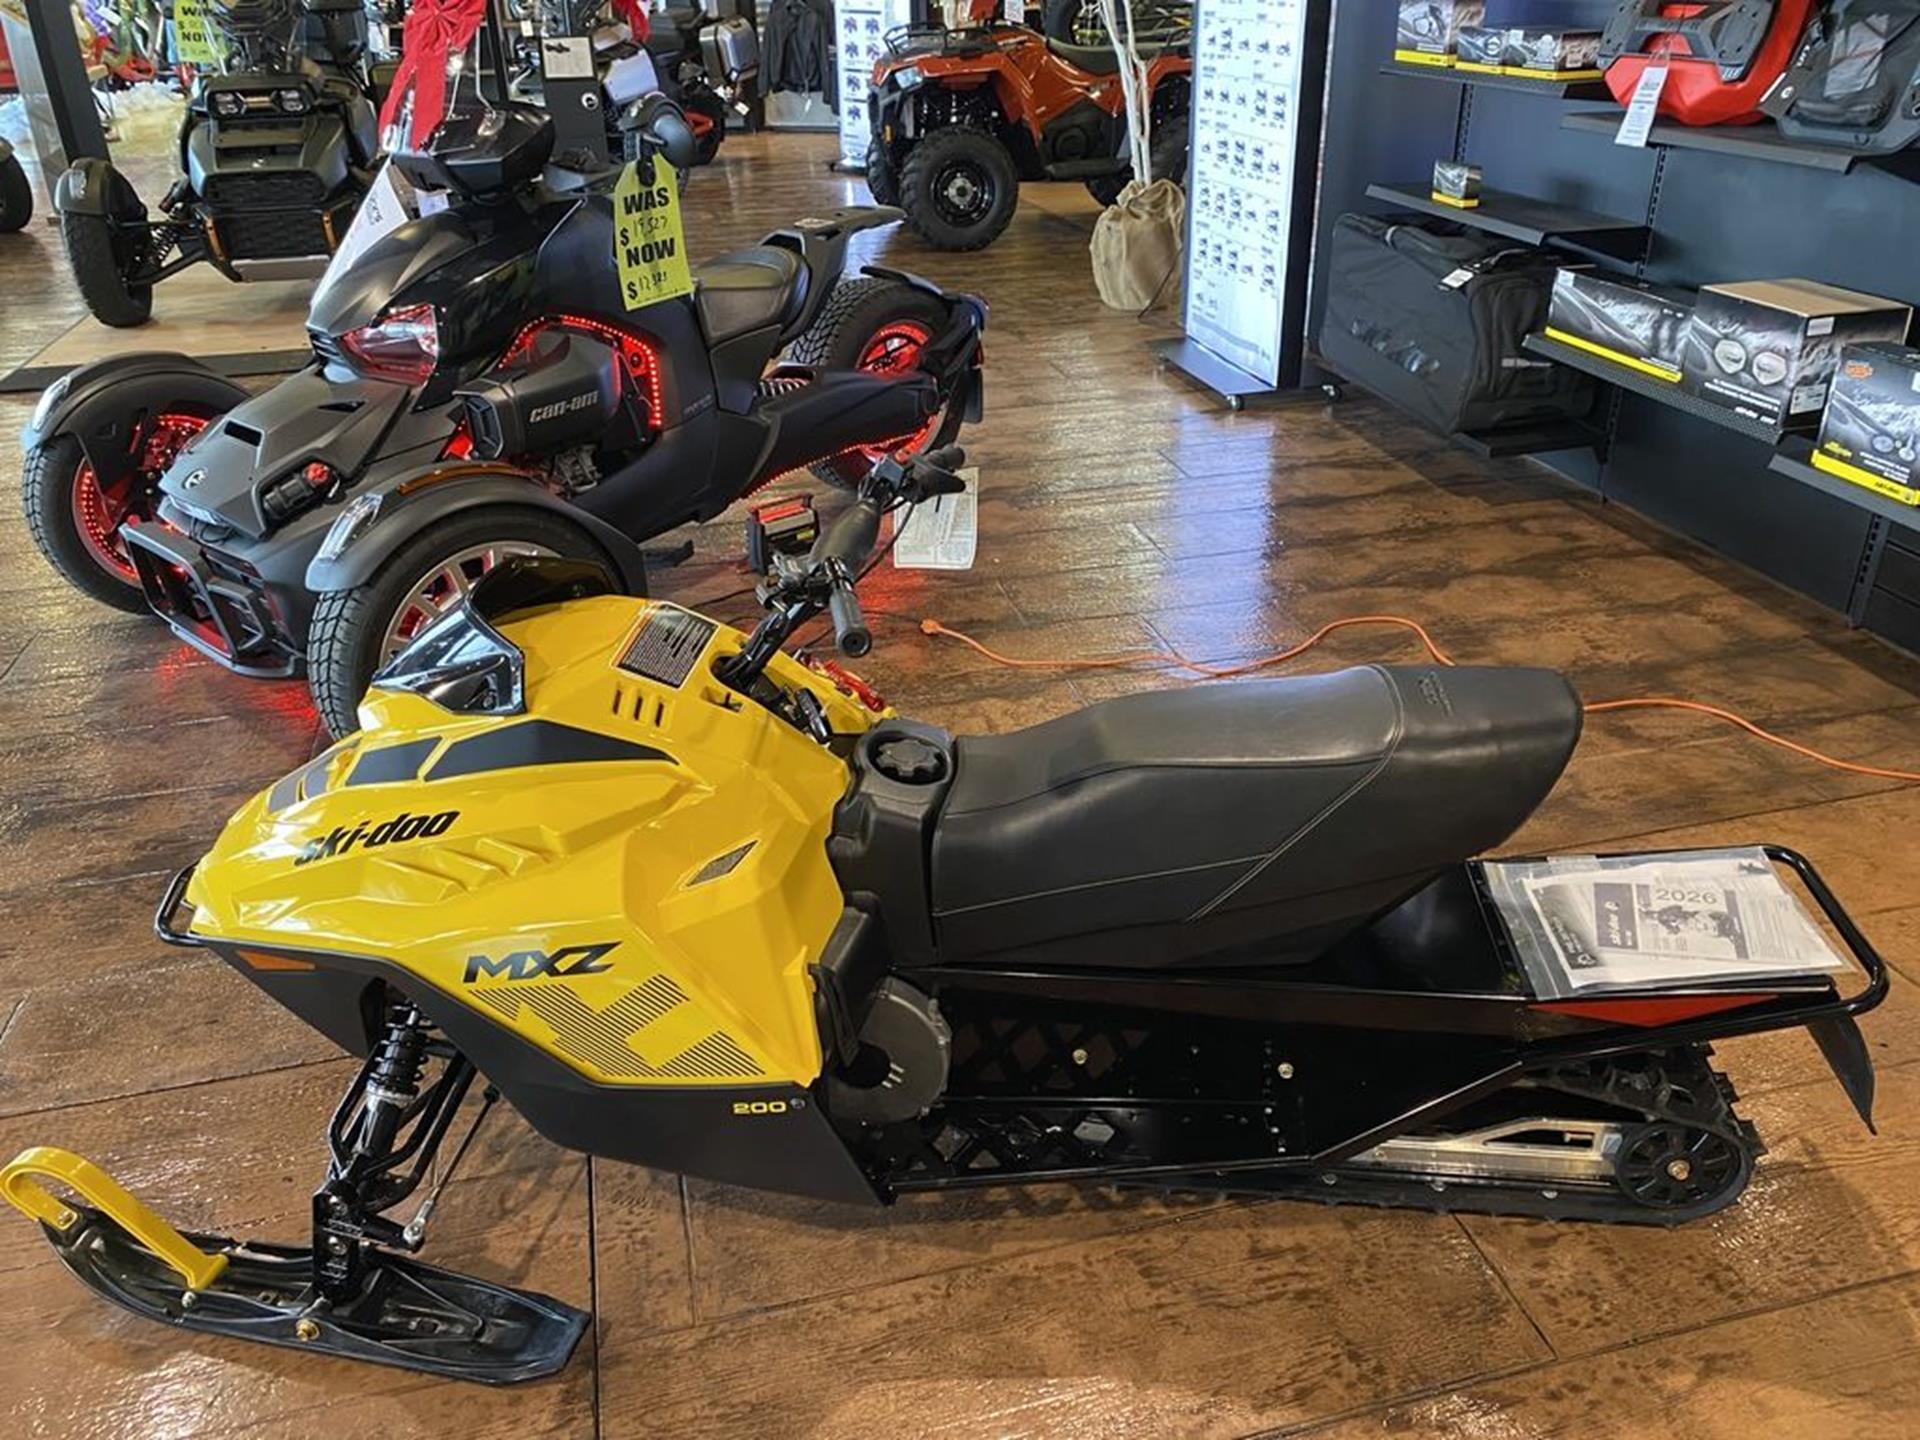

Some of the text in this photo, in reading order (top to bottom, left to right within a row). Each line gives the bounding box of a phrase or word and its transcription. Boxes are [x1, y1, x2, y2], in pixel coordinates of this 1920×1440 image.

[623, 187, 670, 215] WAS
[619, 227, 630, 247] $
[626, 238, 675, 268] NOW
[626, 280, 638, 300] $
[529, 390, 599, 423] can-am
[294, 811, 460, 866] ski-doo
[1656, 888, 1718, 905] 2026
[463, 940, 624, 983] MXZ
[733, 1101, 787, 1115] 200
